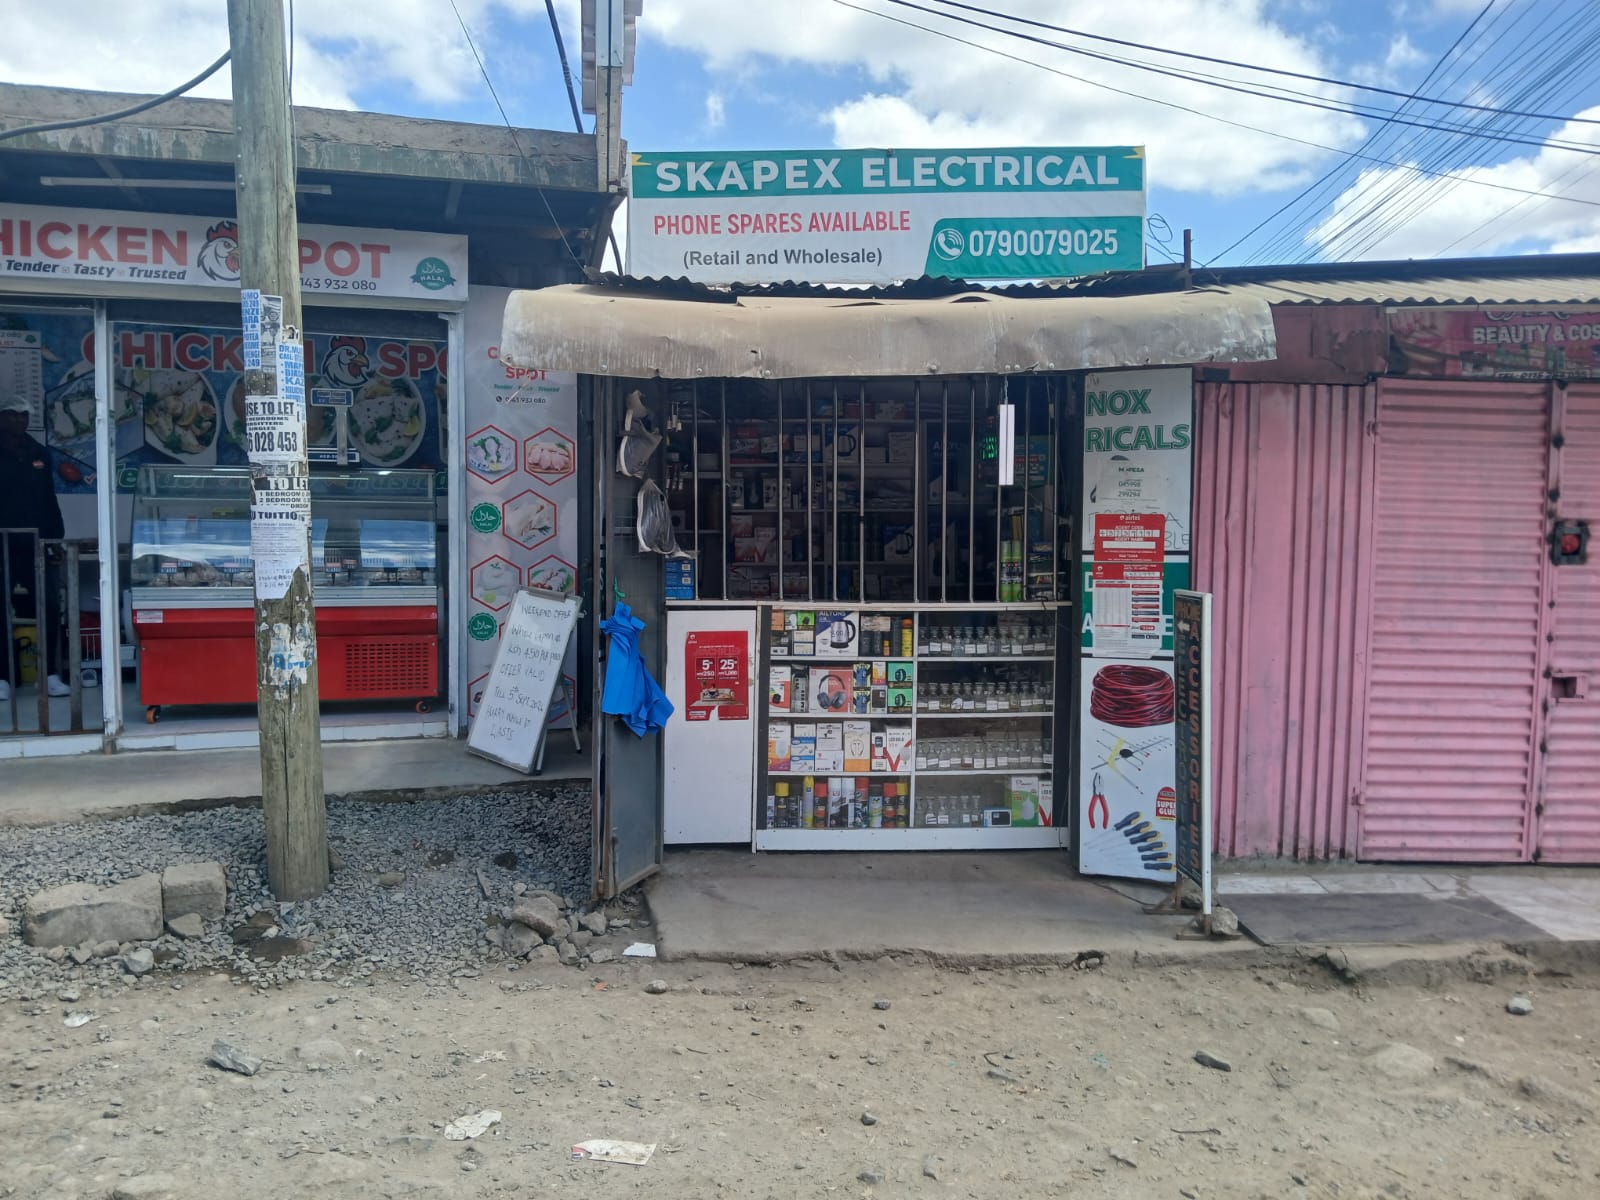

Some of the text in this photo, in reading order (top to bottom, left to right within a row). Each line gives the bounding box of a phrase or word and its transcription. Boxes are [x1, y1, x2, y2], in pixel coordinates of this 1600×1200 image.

[656, 154, 1120, 193] SKAPEX ELECTRICAL
[653, 210, 911, 236] PHONE SPARES AVAILABLE
[969, 229, 1119, 257] 0790079025
[298, 239, 391, 279] POT
[682, 247, 882, 267] (Retail and Wholesale)
[6, 259, 187, 280] Tender Tasty Trusted
[420, 275, 445, 283] HALAL
[324, 278, 349, 290] 932
[352, 279, 377, 291] 080
[1473, 325, 1550, 345] BEAUTY
[1553, 326, 1565, 342] &
[260, 402, 274, 414] TO
[278, 402, 294, 414] LET
[1086, 389, 1152, 416] NOX
[255, 432, 274, 452] 028
[277, 432, 297, 452] 453
[1085, 424, 1190, 452] RICALS
[267, 478, 289, 489] TO
[258, 511, 307, 521] TUITIO
[720, 659, 735, 670] 25
[1188, 621, 1201, 869] ACCESSORIES
[1157, 801, 1176, 809] SUPE
